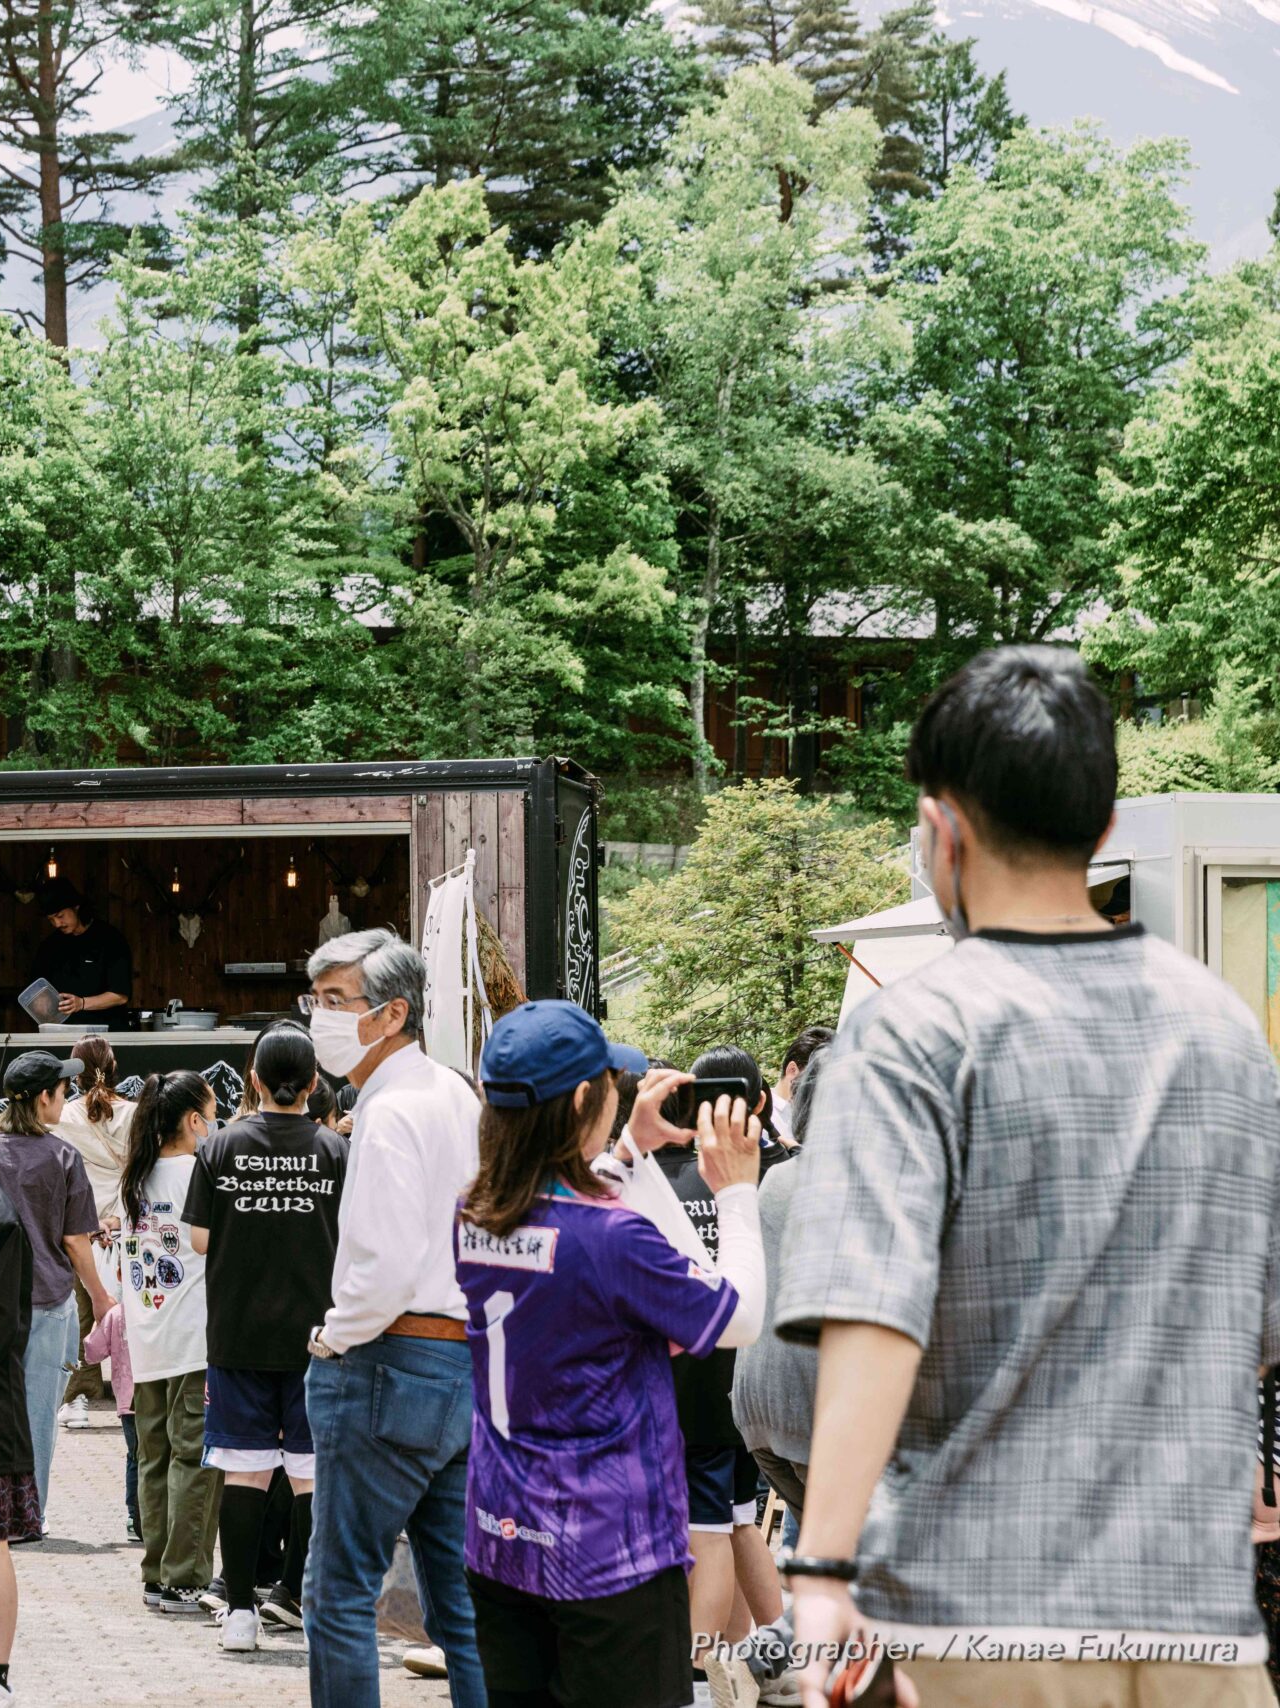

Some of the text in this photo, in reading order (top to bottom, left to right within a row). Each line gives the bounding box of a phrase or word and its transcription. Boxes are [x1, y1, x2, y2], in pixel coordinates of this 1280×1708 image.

[216, 1176, 335, 1195] Basketball
[235, 1196, 314, 1212] CLUB
[483, 1290, 515, 1440] 1
